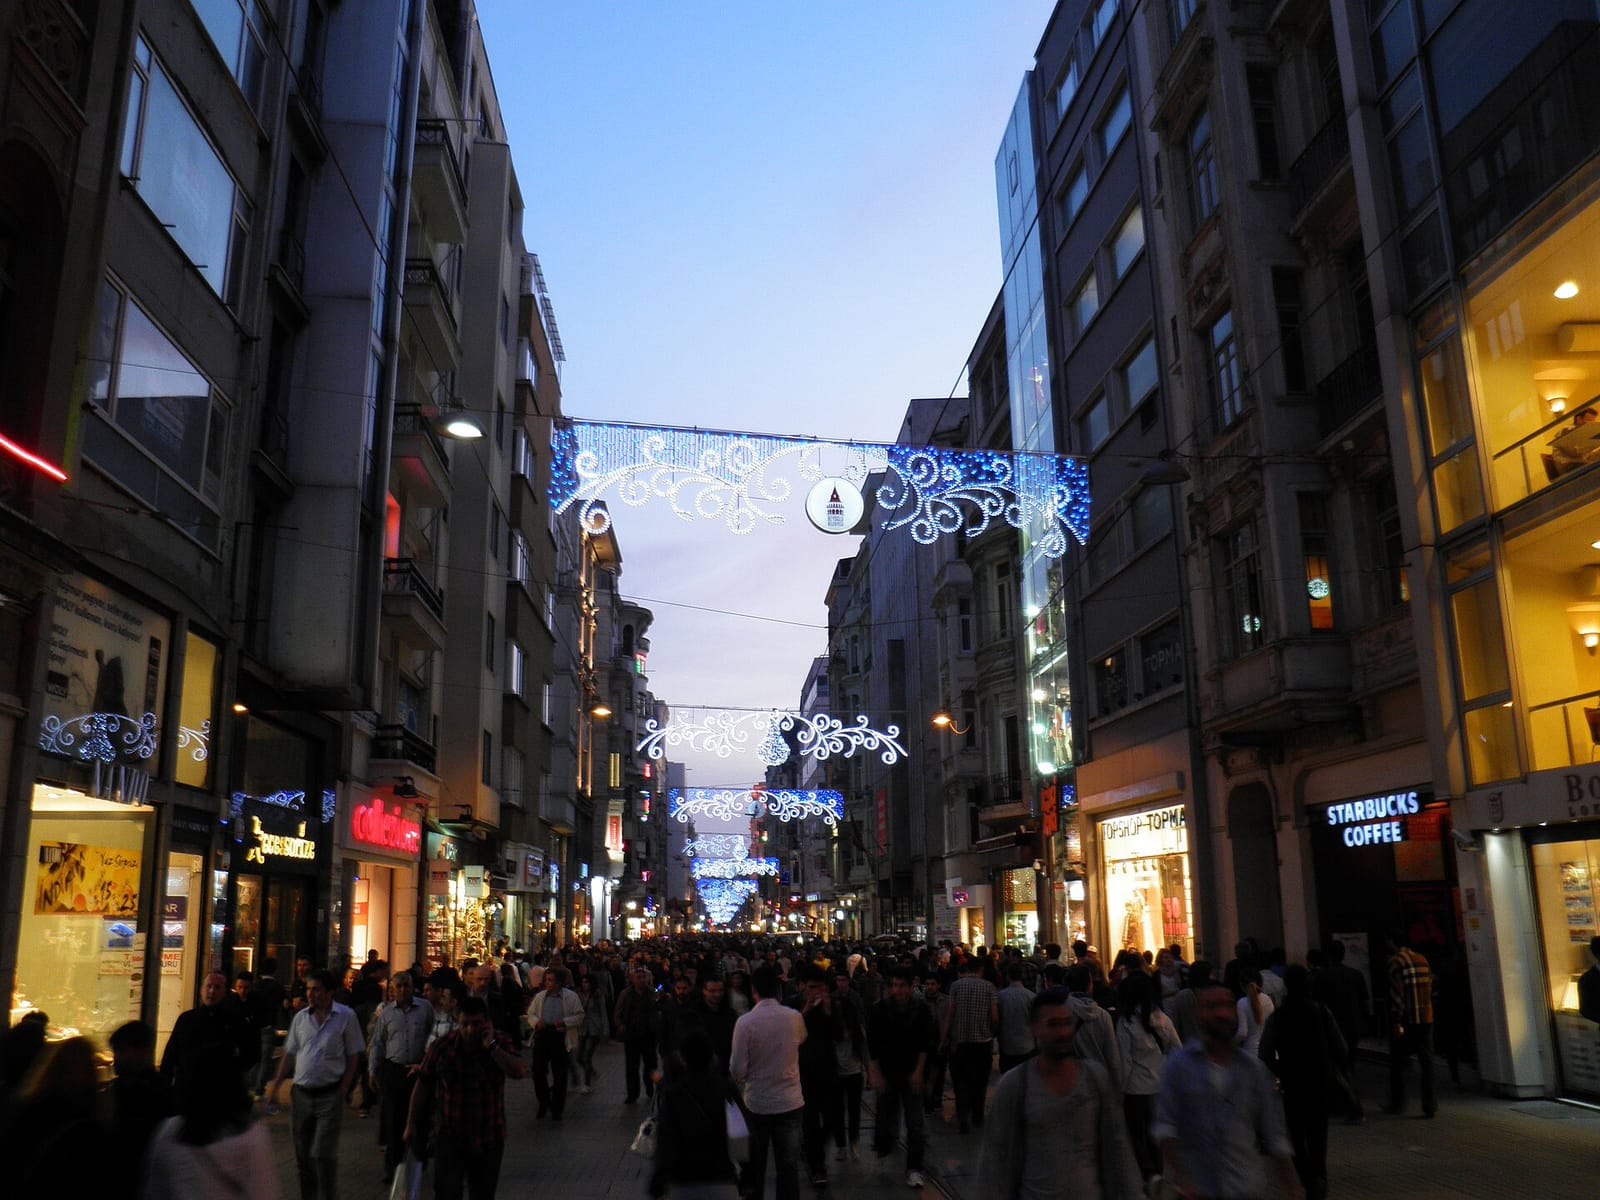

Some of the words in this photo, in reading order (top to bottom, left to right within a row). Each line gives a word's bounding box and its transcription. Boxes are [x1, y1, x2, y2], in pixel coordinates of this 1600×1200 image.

[1327, 791, 1420, 827] STARBUCKS
[1101, 815, 1143, 841] TOPSHOP
[1343, 821, 1402, 848] COFFEE
